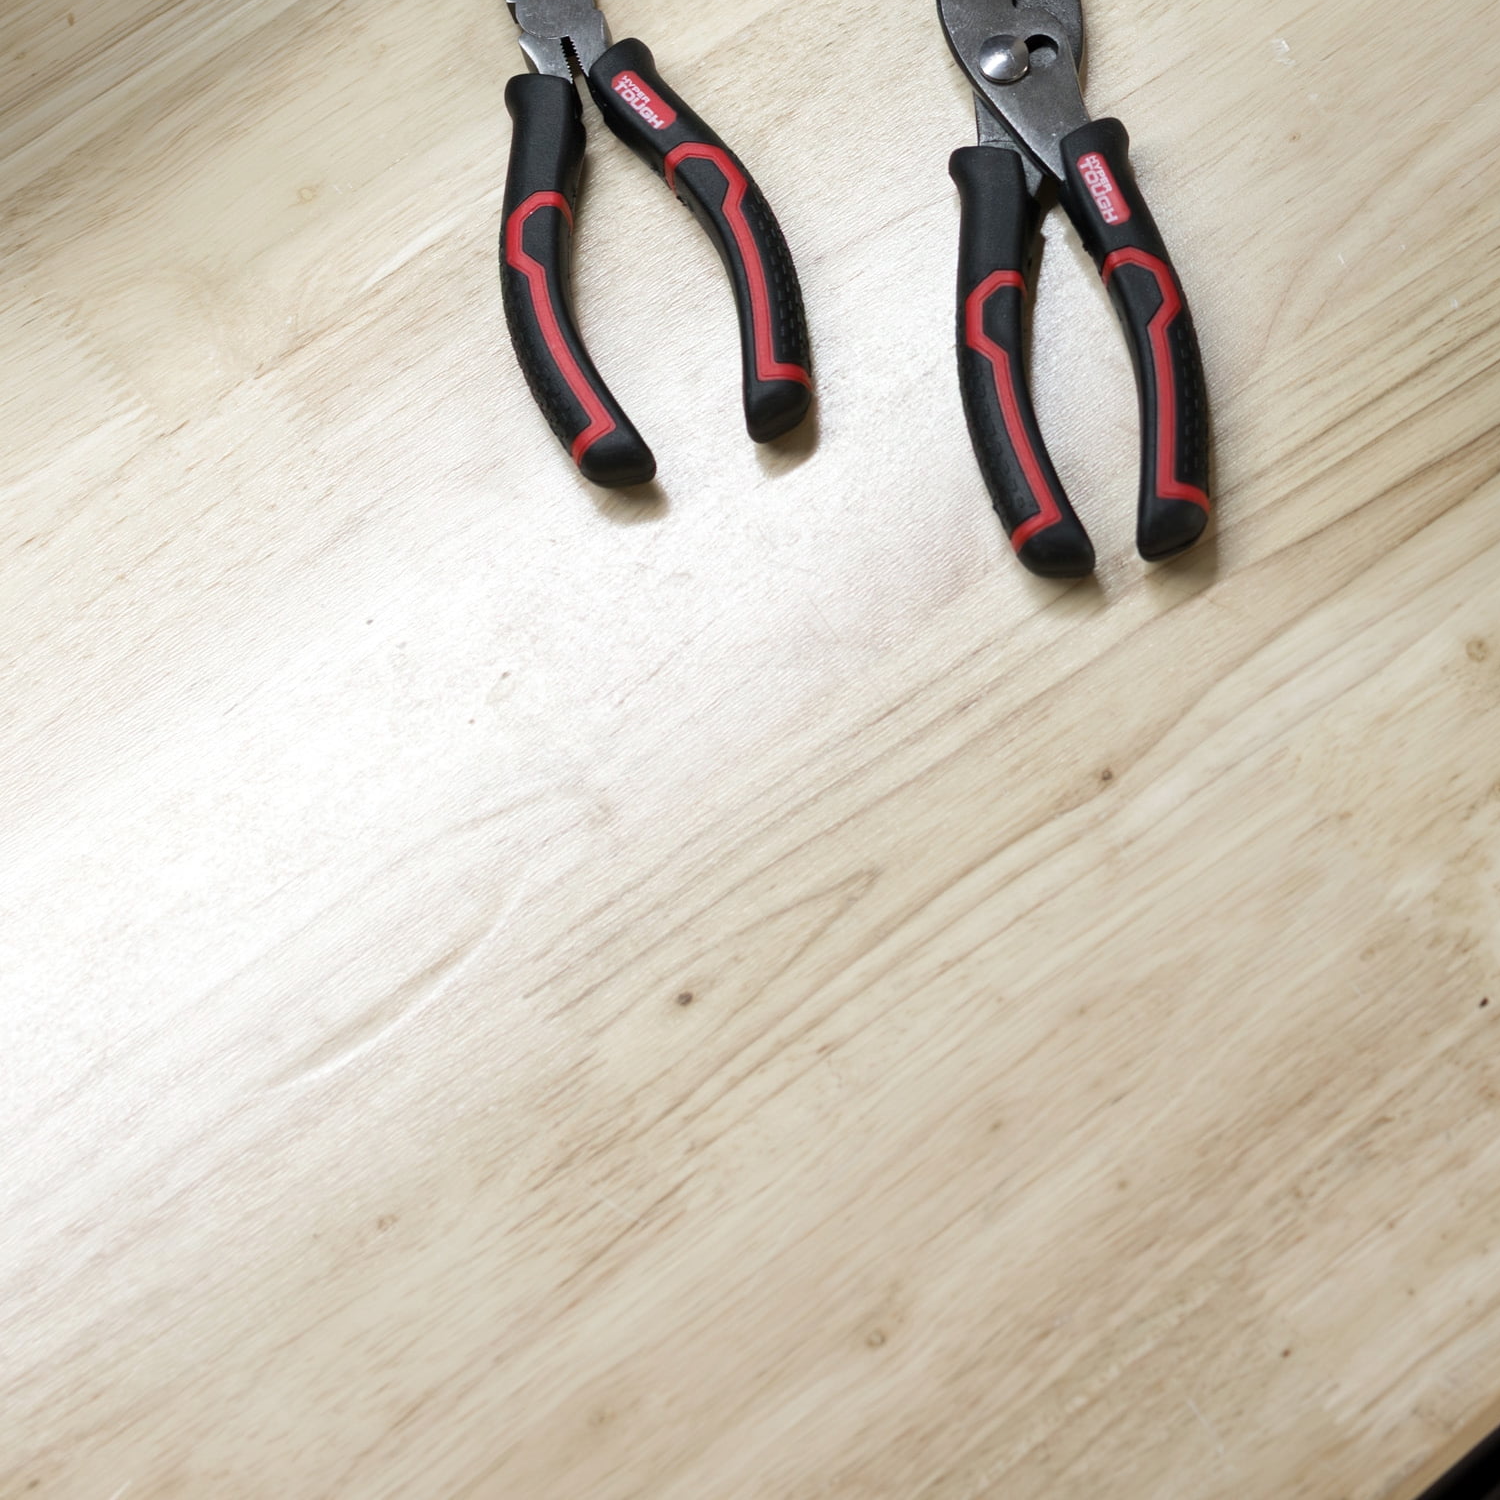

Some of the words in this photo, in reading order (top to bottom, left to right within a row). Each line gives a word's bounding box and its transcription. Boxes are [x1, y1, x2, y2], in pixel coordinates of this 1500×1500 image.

[614, 80, 665, 130] TOUGH
[621, 75, 651, 104] HYPER
[1079, 157, 1119, 224] TOUGH
[1088, 155, 1113, 193] HYPER
